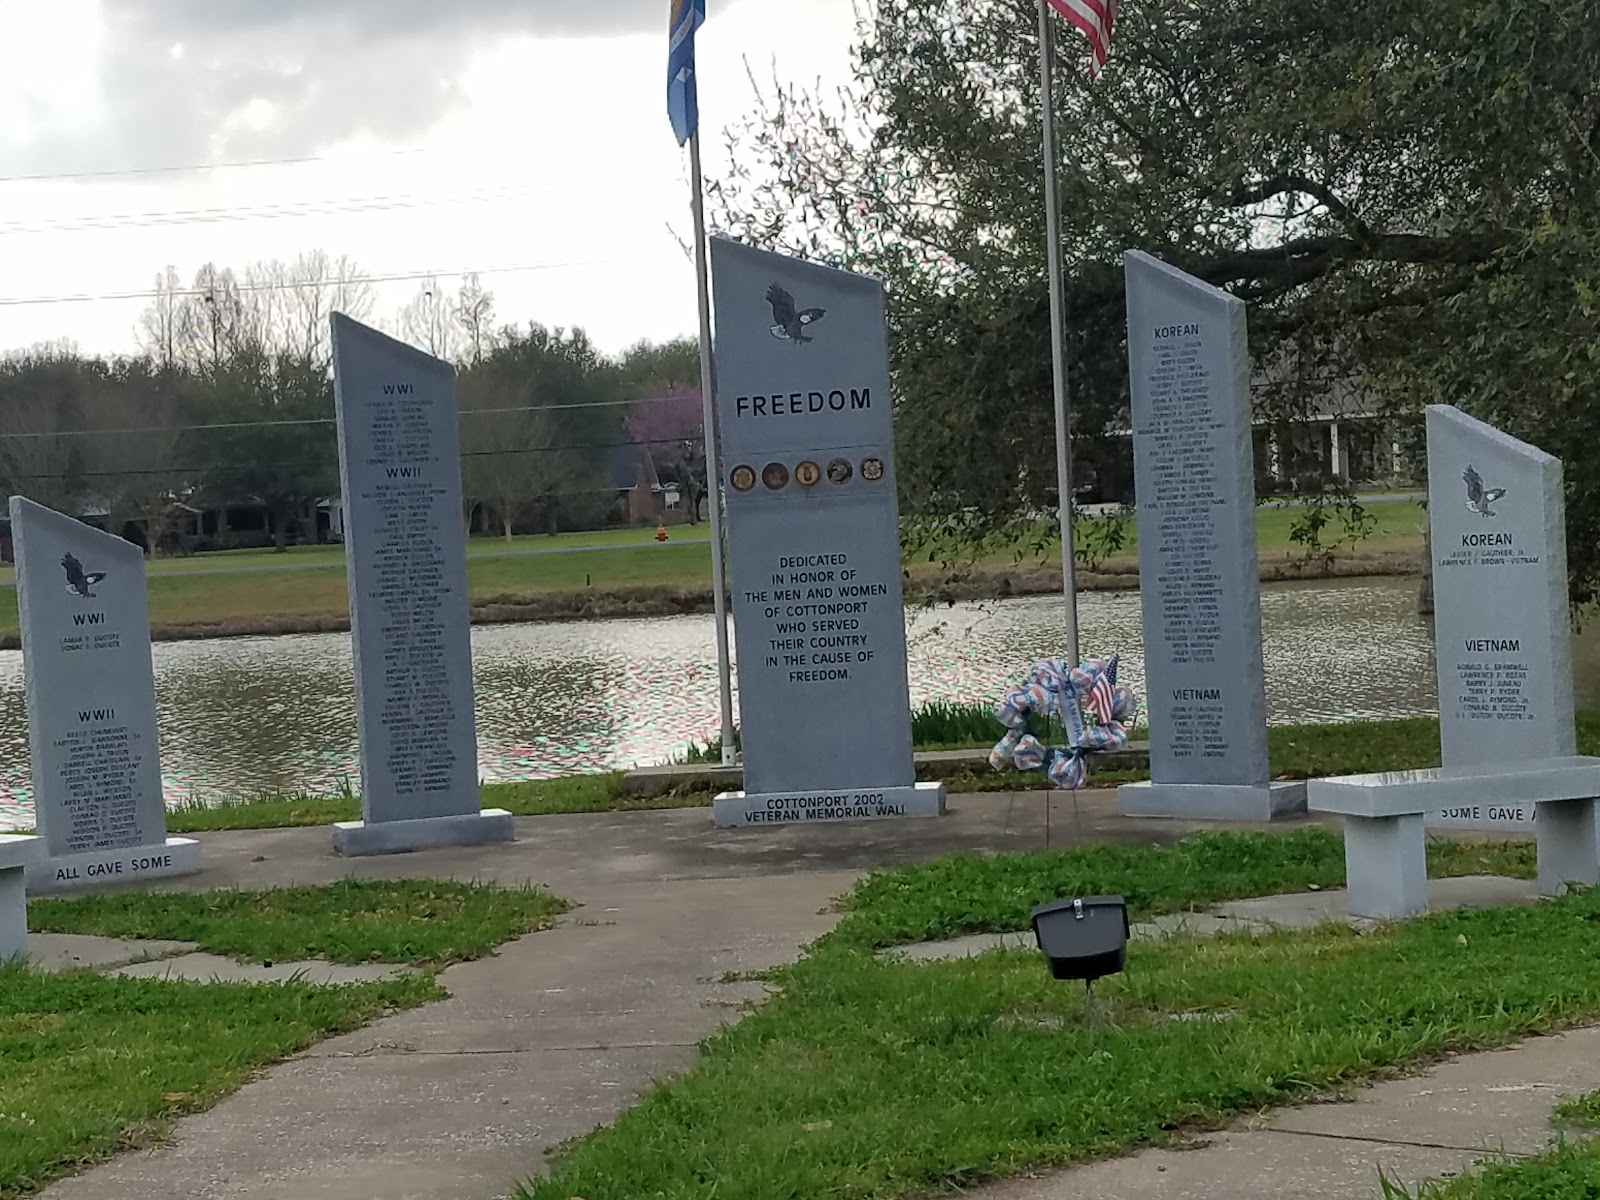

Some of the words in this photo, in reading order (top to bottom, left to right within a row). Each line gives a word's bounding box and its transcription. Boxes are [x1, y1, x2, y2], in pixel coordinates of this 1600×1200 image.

[1155, 324, 1199, 339] KOREAN
[383, 384, 414, 395] WWI
[736, 388, 871, 417] FREEDOM
[386, 467, 421, 479] WWII
[1462, 533, 1512, 547] KOREAN
[780, 553, 847, 568] DEDICATED
[772, 574, 784, 585] IN
[790, 571, 834, 584] HONOR
[840, 569, 857, 581] OF
[745, 591, 768, 602] THE
[774, 589, 801, 601] MEN
[806, 587, 833, 599] AND
[838, 584, 888, 598] WOMEN
[765, 607, 780, 618] OF
[786, 601, 868, 617] COTTONPORT
[73, 612, 104, 626] WWI
[776, 622, 806, 633] WHO
[812, 619, 859, 632] SERVED
[770, 638, 804, 650] THEIR
[810, 634, 868, 648] COUNTRY
[1465, 639, 1520, 652] VIETNAM
[766, 656, 778, 667] IN
[783, 655, 806, 666] THE
[812, 651, 851, 665] CAUSE
[857, 651, 874, 662] OF
[789, 669, 852, 682] FREEDOM.
[1172, 688, 1221, 701] VIETNAM
[78, 708, 116, 722] WWII
[767, 796, 849, 810] COTTONPORT
[854, 793, 884, 806] 2002
[745, 809, 800, 823] VETERAN
[806, 806, 871, 820] MEMORIAL
[875, 804, 906, 816] WALL
[1489, 808, 1523, 821] GAVE
[56, 867, 80, 881] ALL
[87, 861, 123, 877] GAVE
[131, 855, 172, 871] SOME
